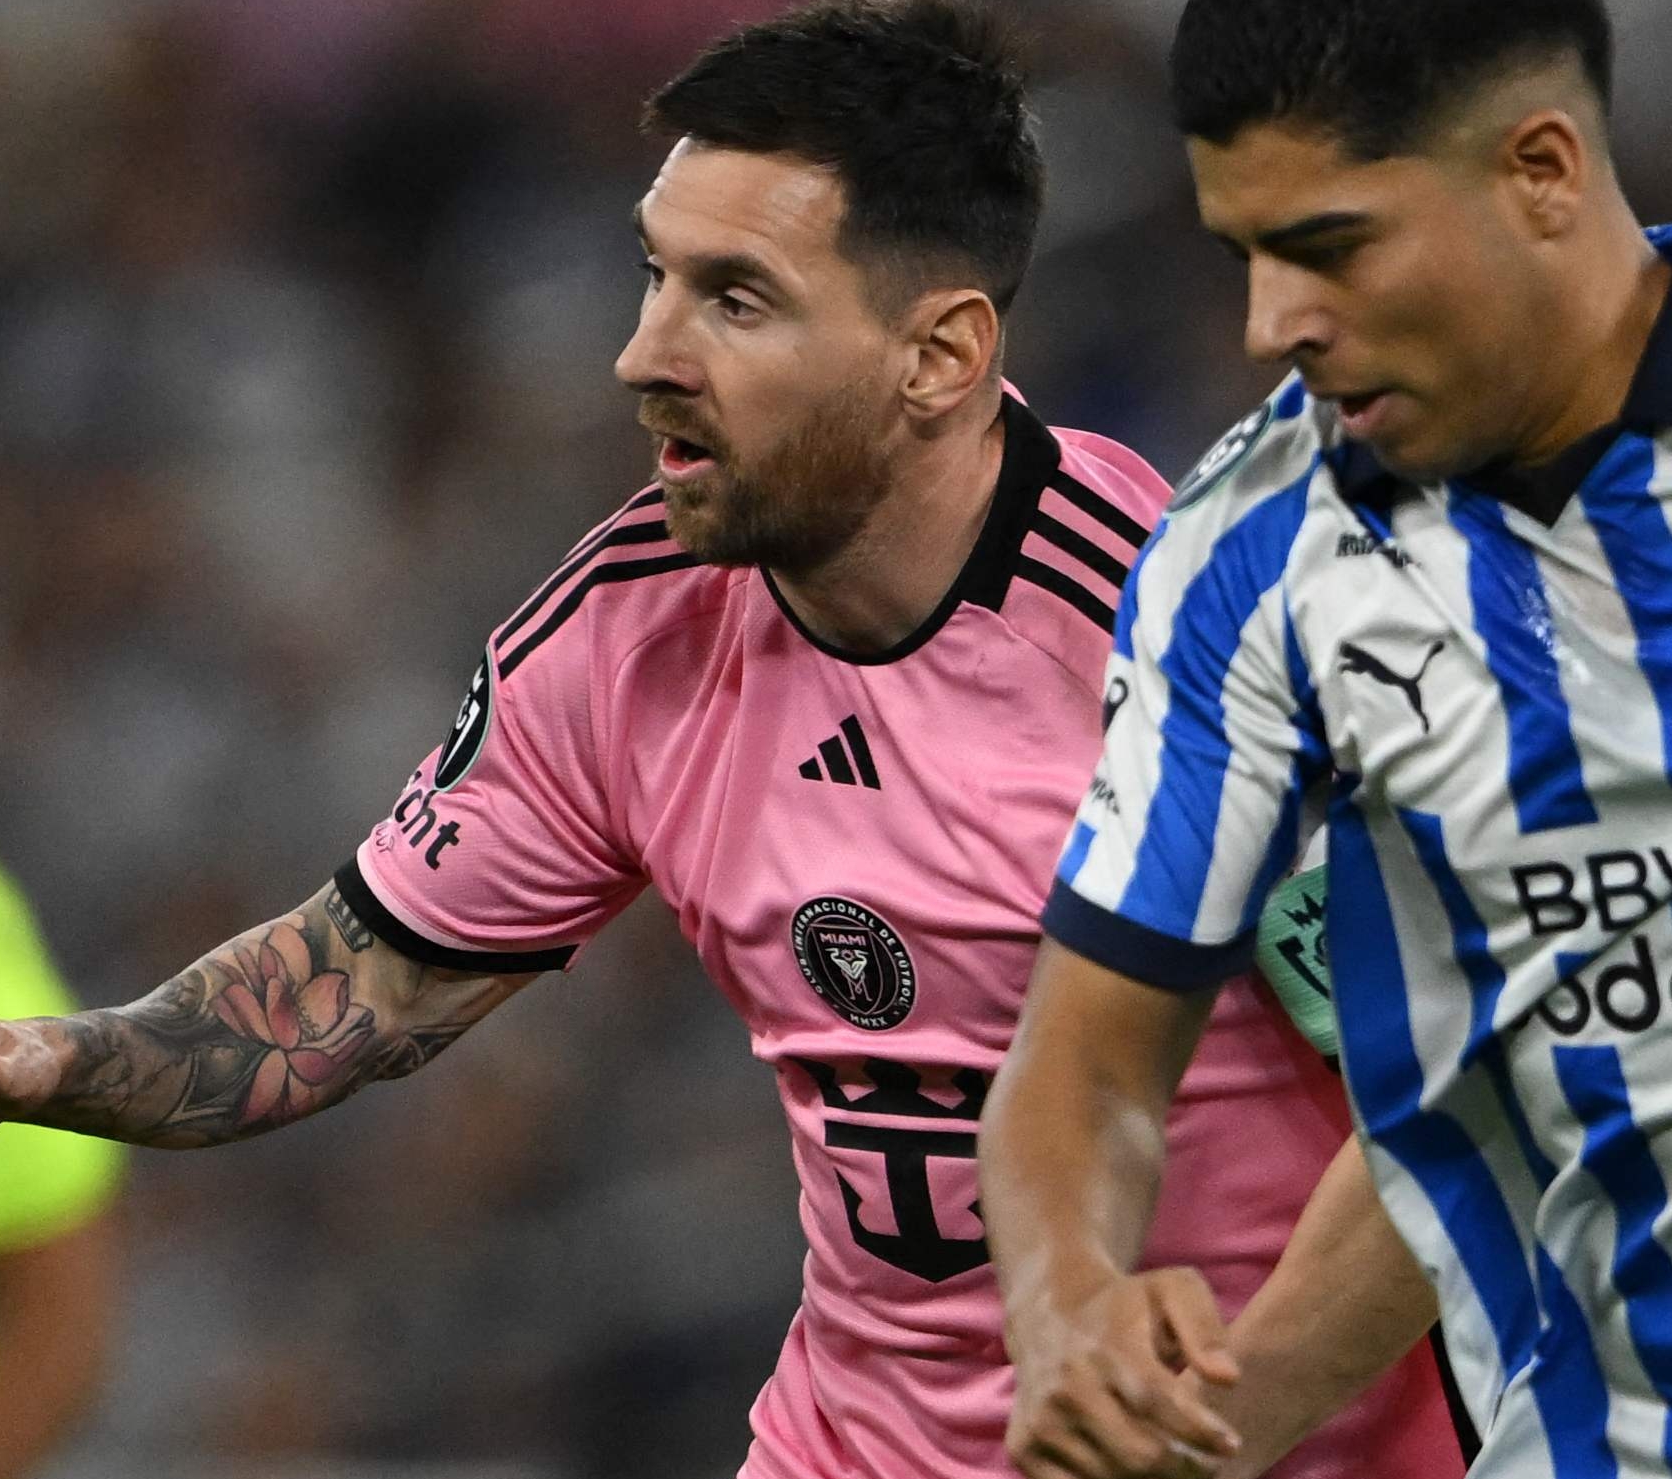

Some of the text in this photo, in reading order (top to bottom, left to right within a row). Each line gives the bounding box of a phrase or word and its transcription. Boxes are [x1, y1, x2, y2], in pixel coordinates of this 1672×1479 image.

[794, 901, 876, 951] INTERNACIONAL
[878, 928, 897, 946] DE
[820, 932, 867, 946] MIAMI
